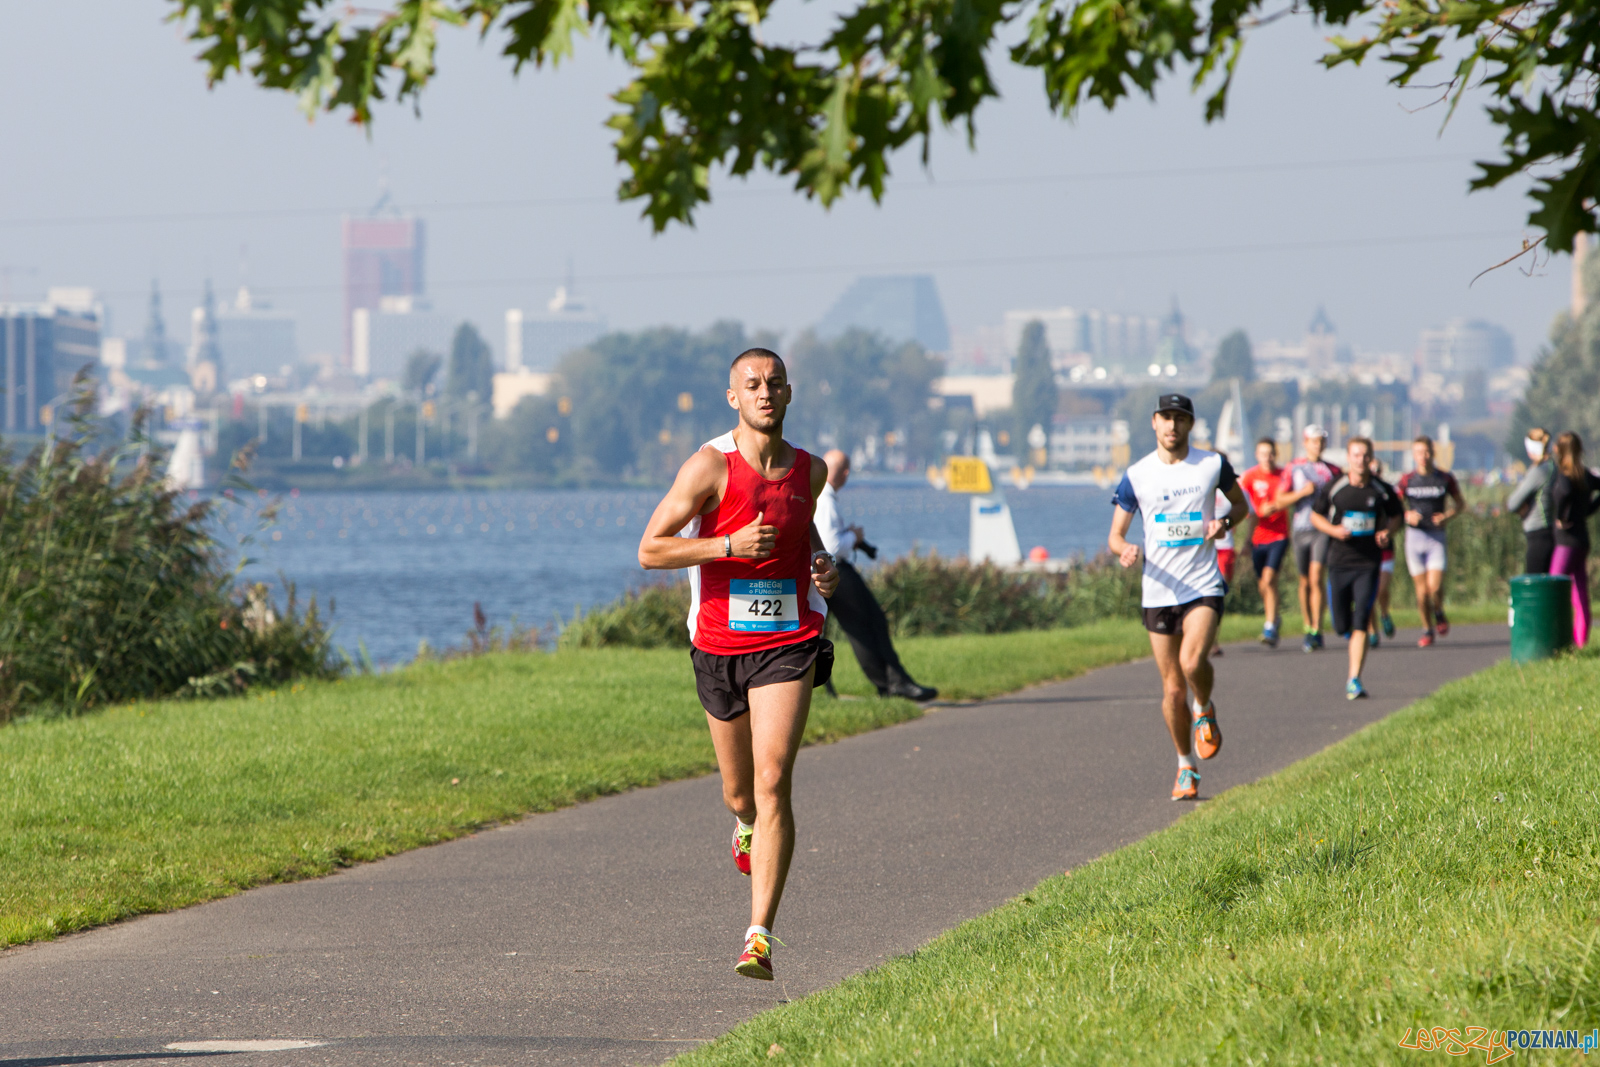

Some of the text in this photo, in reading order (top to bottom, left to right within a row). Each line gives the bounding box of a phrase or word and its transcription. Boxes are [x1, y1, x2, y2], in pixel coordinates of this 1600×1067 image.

[1168, 525, 1191, 537] 562
[749, 581, 782, 589] zaBIEGaj
[748, 599, 782, 616] 422
